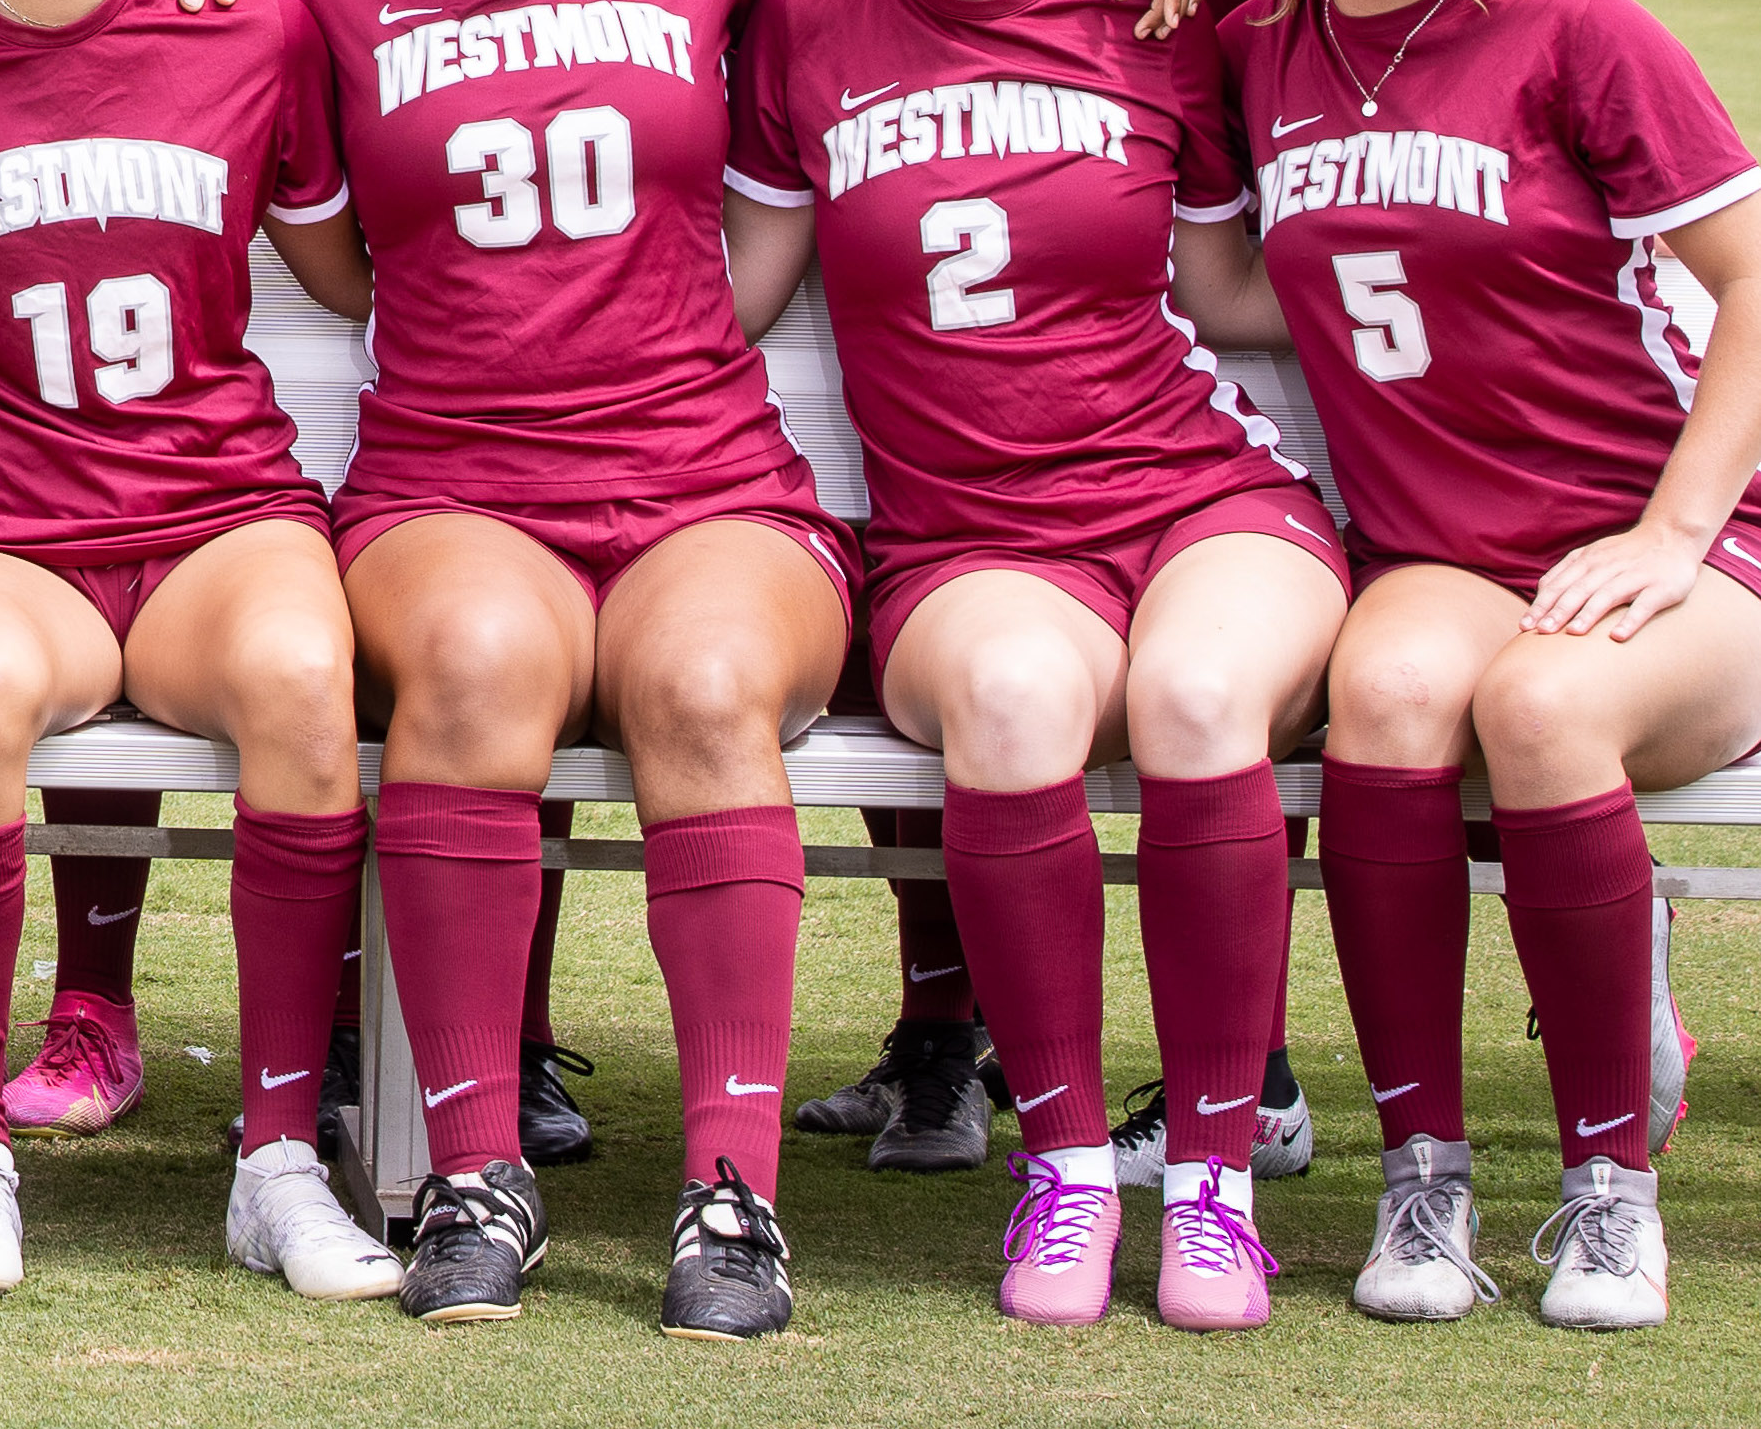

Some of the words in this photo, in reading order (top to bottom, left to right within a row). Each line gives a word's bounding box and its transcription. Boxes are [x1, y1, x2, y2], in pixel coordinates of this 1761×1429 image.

[373, 0, 695, 117] WESTMONT
[445, 103, 636, 250] 30
[823, 79, 1136, 201] WESTMONT
[1258, 130, 1510, 242] WESTMONT
[919, 197, 1016, 332] 2
[1331, 249, 1434, 384] 5
[12, 272, 174, 410] 19
